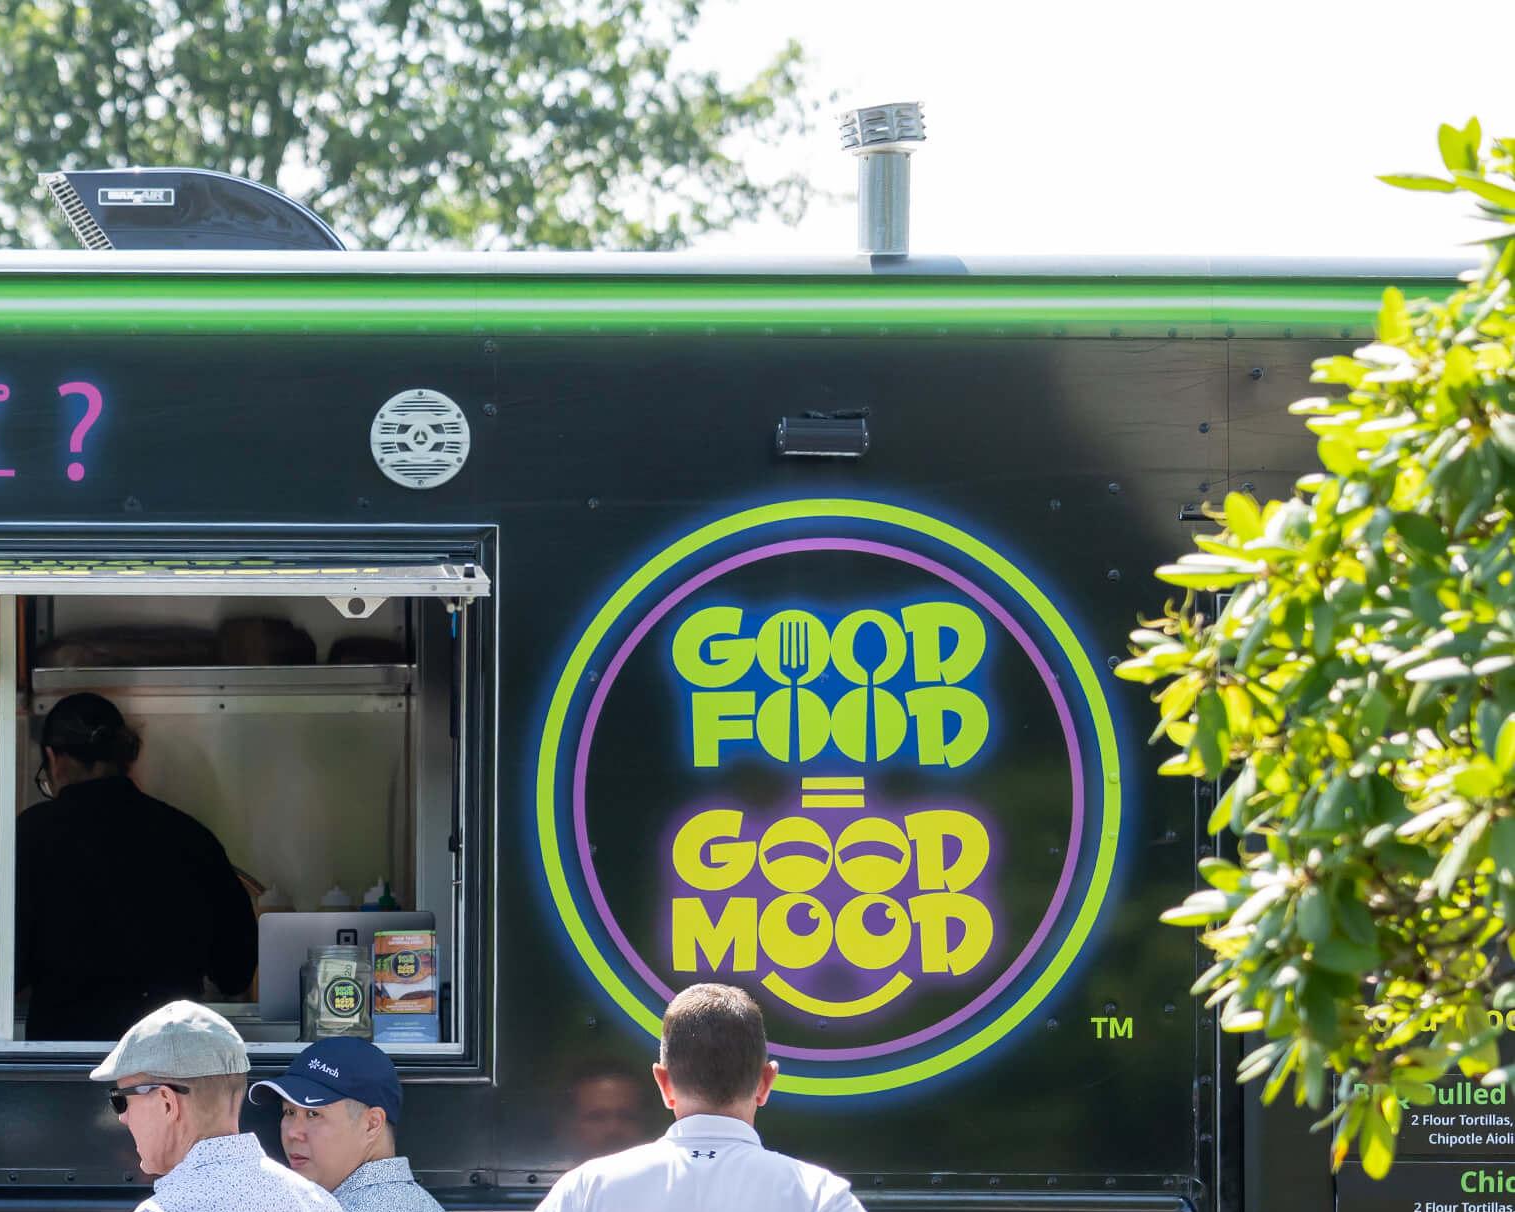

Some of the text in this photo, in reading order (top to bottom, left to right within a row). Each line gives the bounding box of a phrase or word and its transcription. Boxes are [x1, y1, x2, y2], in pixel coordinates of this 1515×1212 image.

[672, 601, 987, 688] GOOD
[691, 685, 990, 768] FOOD
[672, 809, 990, 893] GOOD
[672, 891, 994, 976] MOOD
[1090, 1016, 1133, 1039] TM
[318, 1063, 340, 1079] Arch
[1411, 1113, 1514, 1128] 2 Flour Tortillas,
[1428, 1132, 1483, 1147] Chipotle
